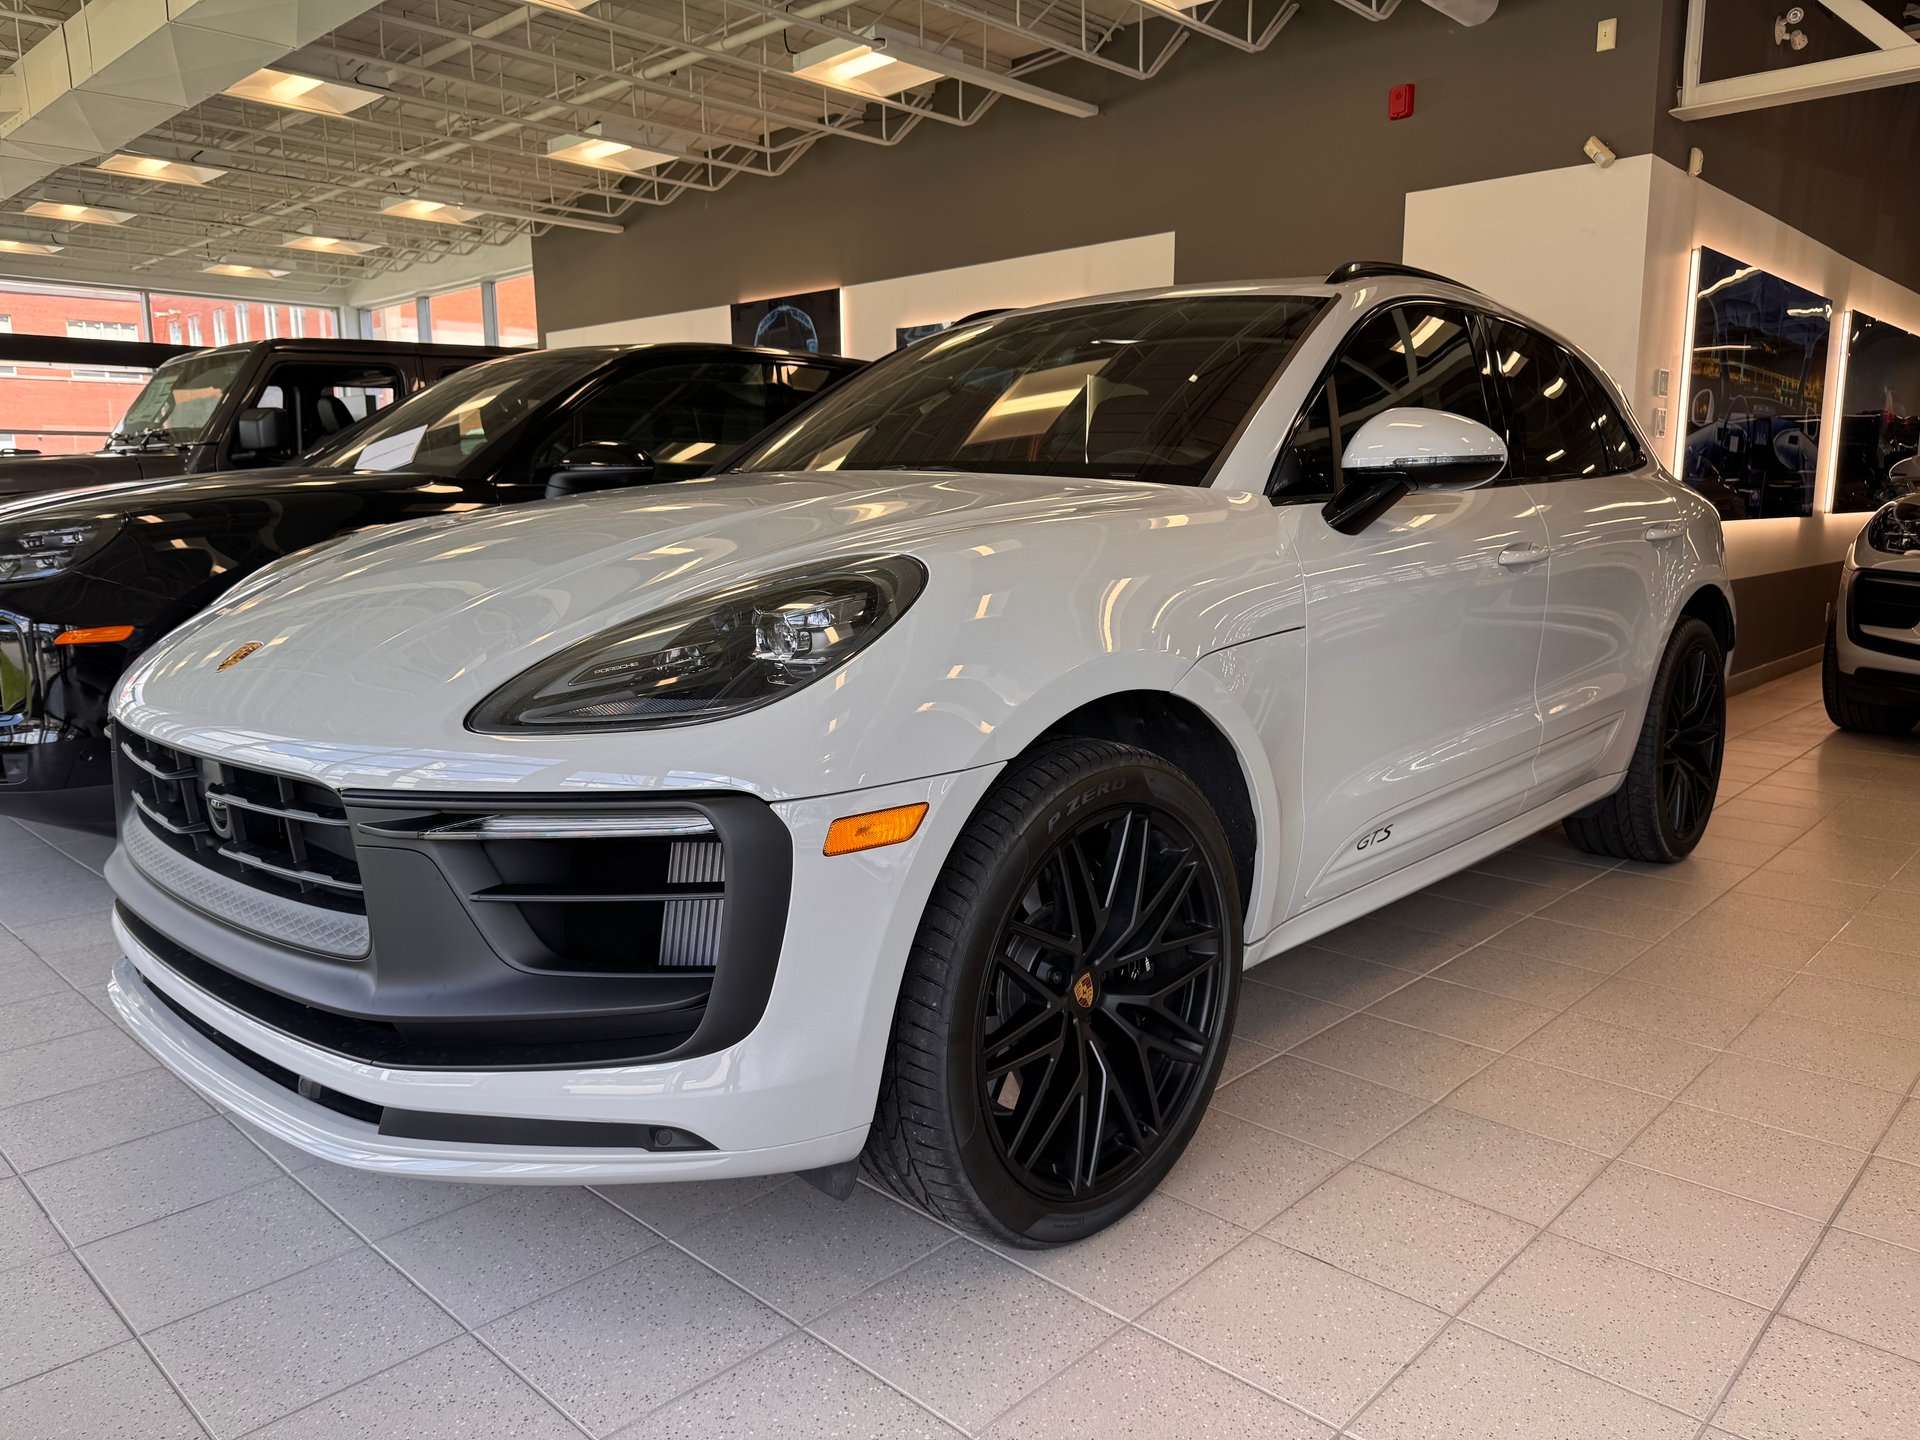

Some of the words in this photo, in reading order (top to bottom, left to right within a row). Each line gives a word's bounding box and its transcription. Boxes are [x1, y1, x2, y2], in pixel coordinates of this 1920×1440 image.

[593, 661, 640, 675] PORSCHE
[1048, 811, 1061, 834] P
[1065, 776, 1128, 817] ZERO
[1356, 823, 1394, 850] GTS
